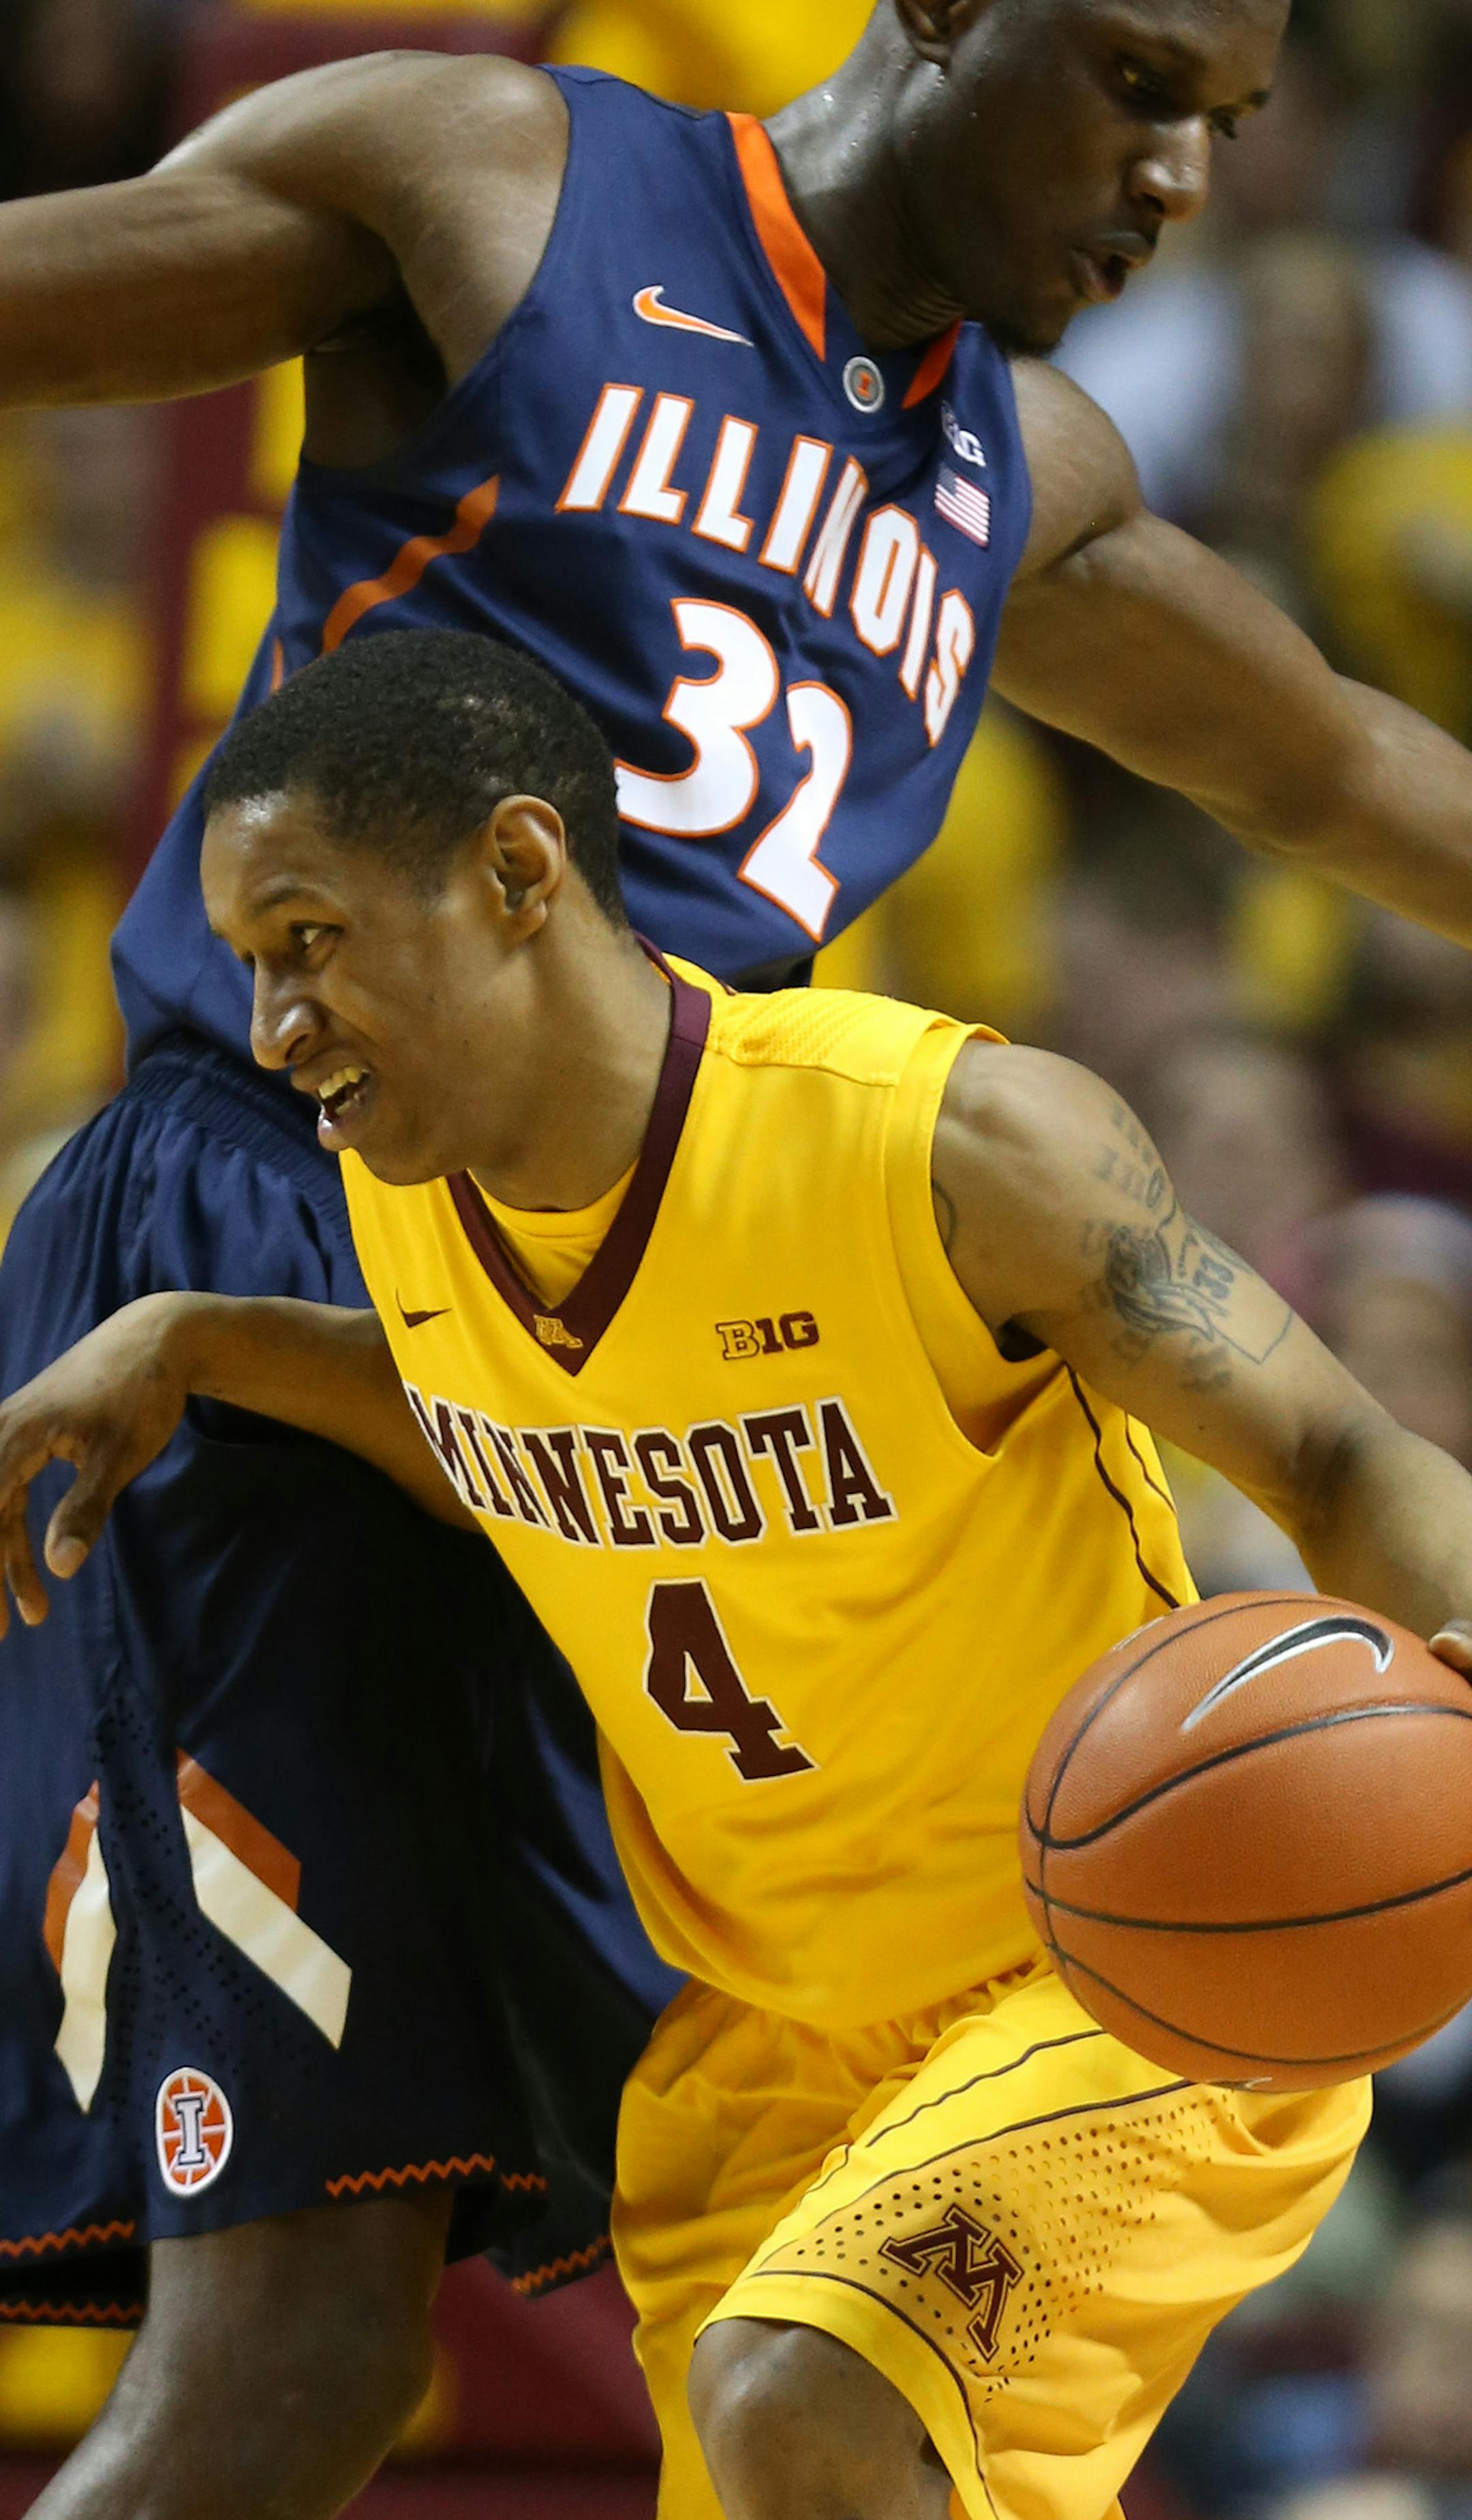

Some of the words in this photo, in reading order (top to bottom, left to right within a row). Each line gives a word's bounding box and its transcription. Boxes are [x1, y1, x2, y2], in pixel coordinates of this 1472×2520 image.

[555, 383, 975, 748] ILLINOIS
[614, 599, 853, 942] 32
[402, 1381, 899, 1550] MINNESOTA
[641, 1576, 821, 1784] 4
[171, 2090, 209, 2171] I
[878, 2203, 1025, 2364] M
